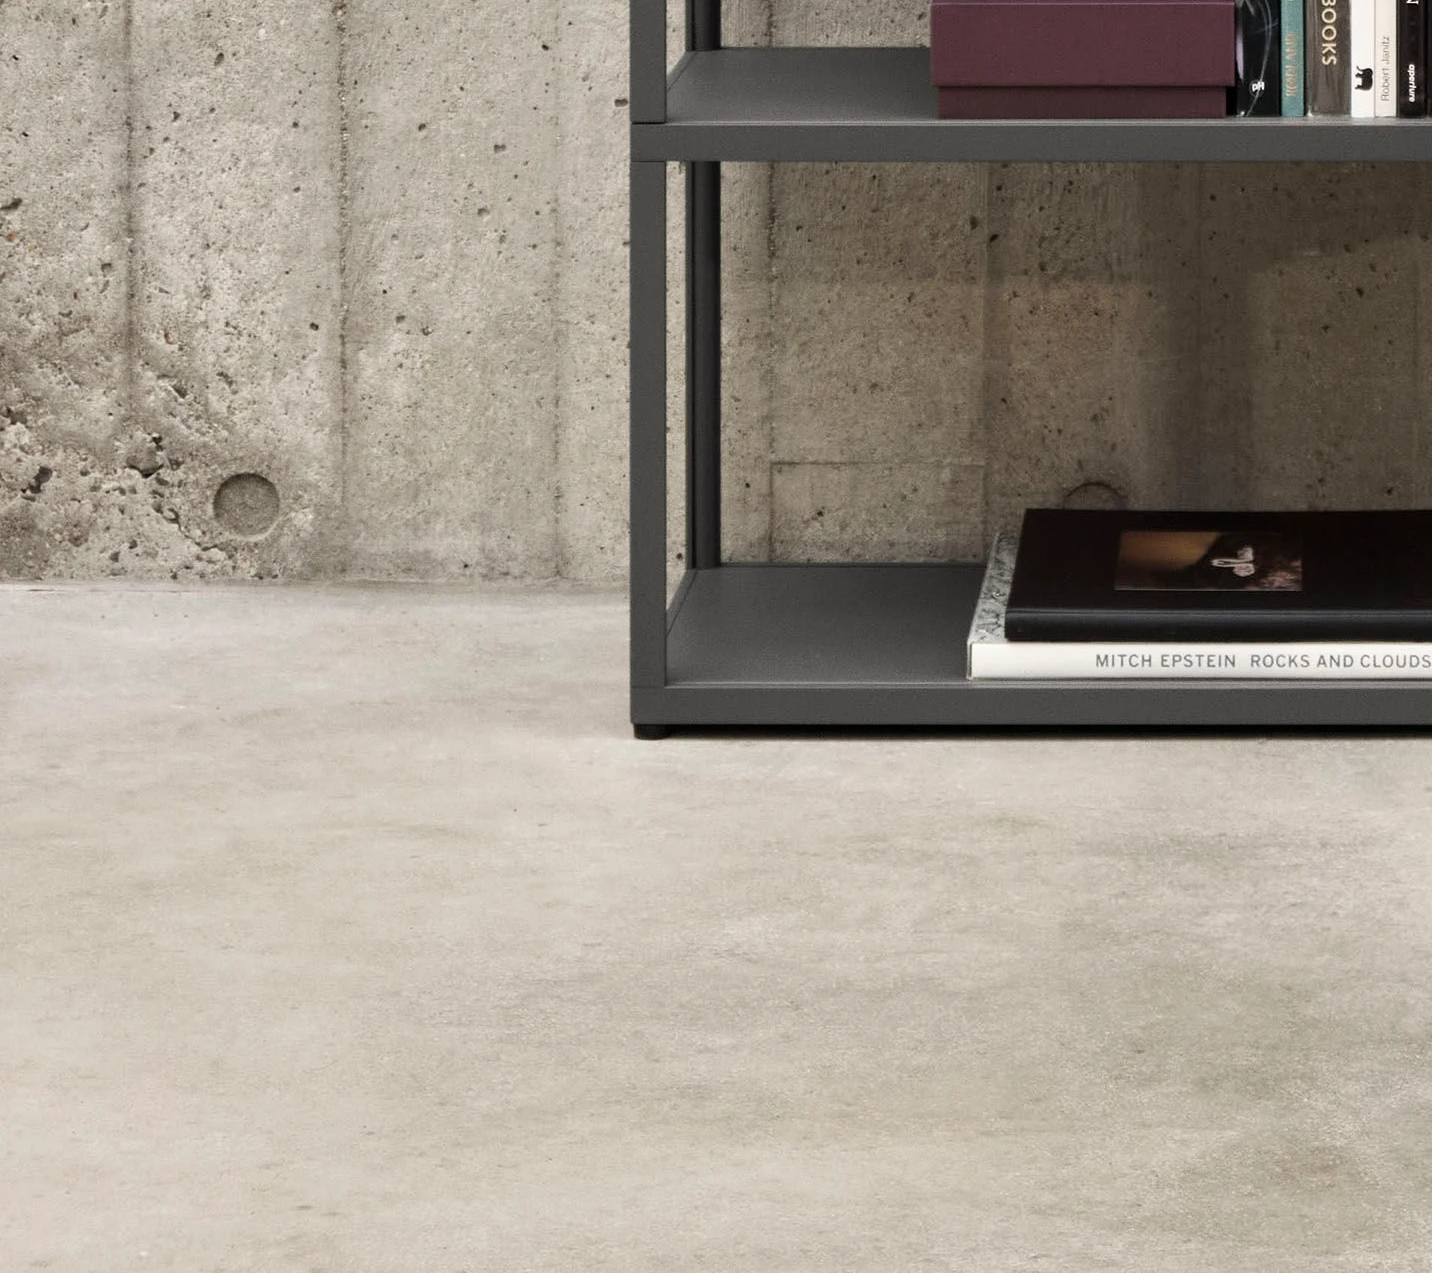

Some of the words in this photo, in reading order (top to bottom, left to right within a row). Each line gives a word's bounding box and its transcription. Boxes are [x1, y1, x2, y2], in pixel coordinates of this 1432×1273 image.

[1380, 36, 1391, 65] Janitz
[1380, 67, 1391, 102] Robert
[1406, 63, 1417, 103] aperture
[1095, 653, 1153, 669] MITCH
[1160, 653, 1236, 669] EPSTEIN
[1250, 653, 1311, 669] ROCKS
[1316, 653, 1355, 669] AND
[1360, 653, 1432, 669] CLOUDS
